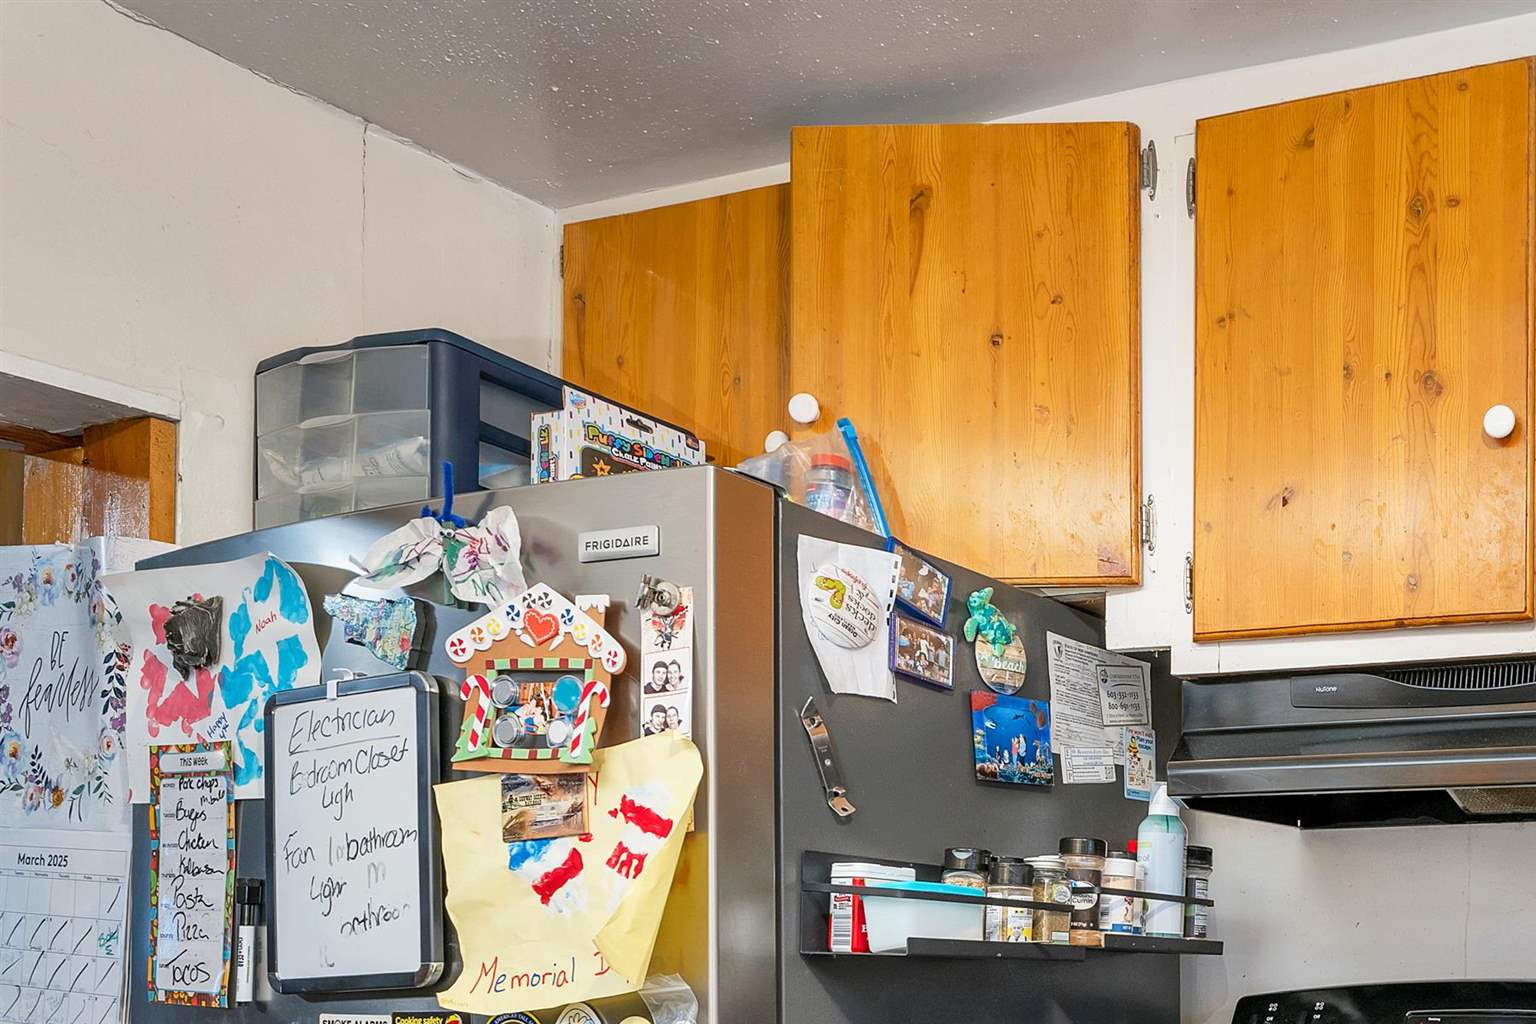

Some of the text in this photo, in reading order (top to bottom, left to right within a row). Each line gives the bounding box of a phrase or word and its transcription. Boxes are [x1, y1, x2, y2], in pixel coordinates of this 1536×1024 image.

[585, 535, 649, 551] FRIGIDAIRE
[255, 611, 278, 635] Noah
[845, 603, 877, 633] decks
[848, 594, 877, 621] docks
[19, 656, 99, 739] fearless
[289, 707, 395, 754] Electrician
[356, 738, 408, 776] Closet
[17, 852, 69, 867] March 2025
[284, 827, 418, 873] Fan bathroom
[470, 956, 575, 994] Memorial
